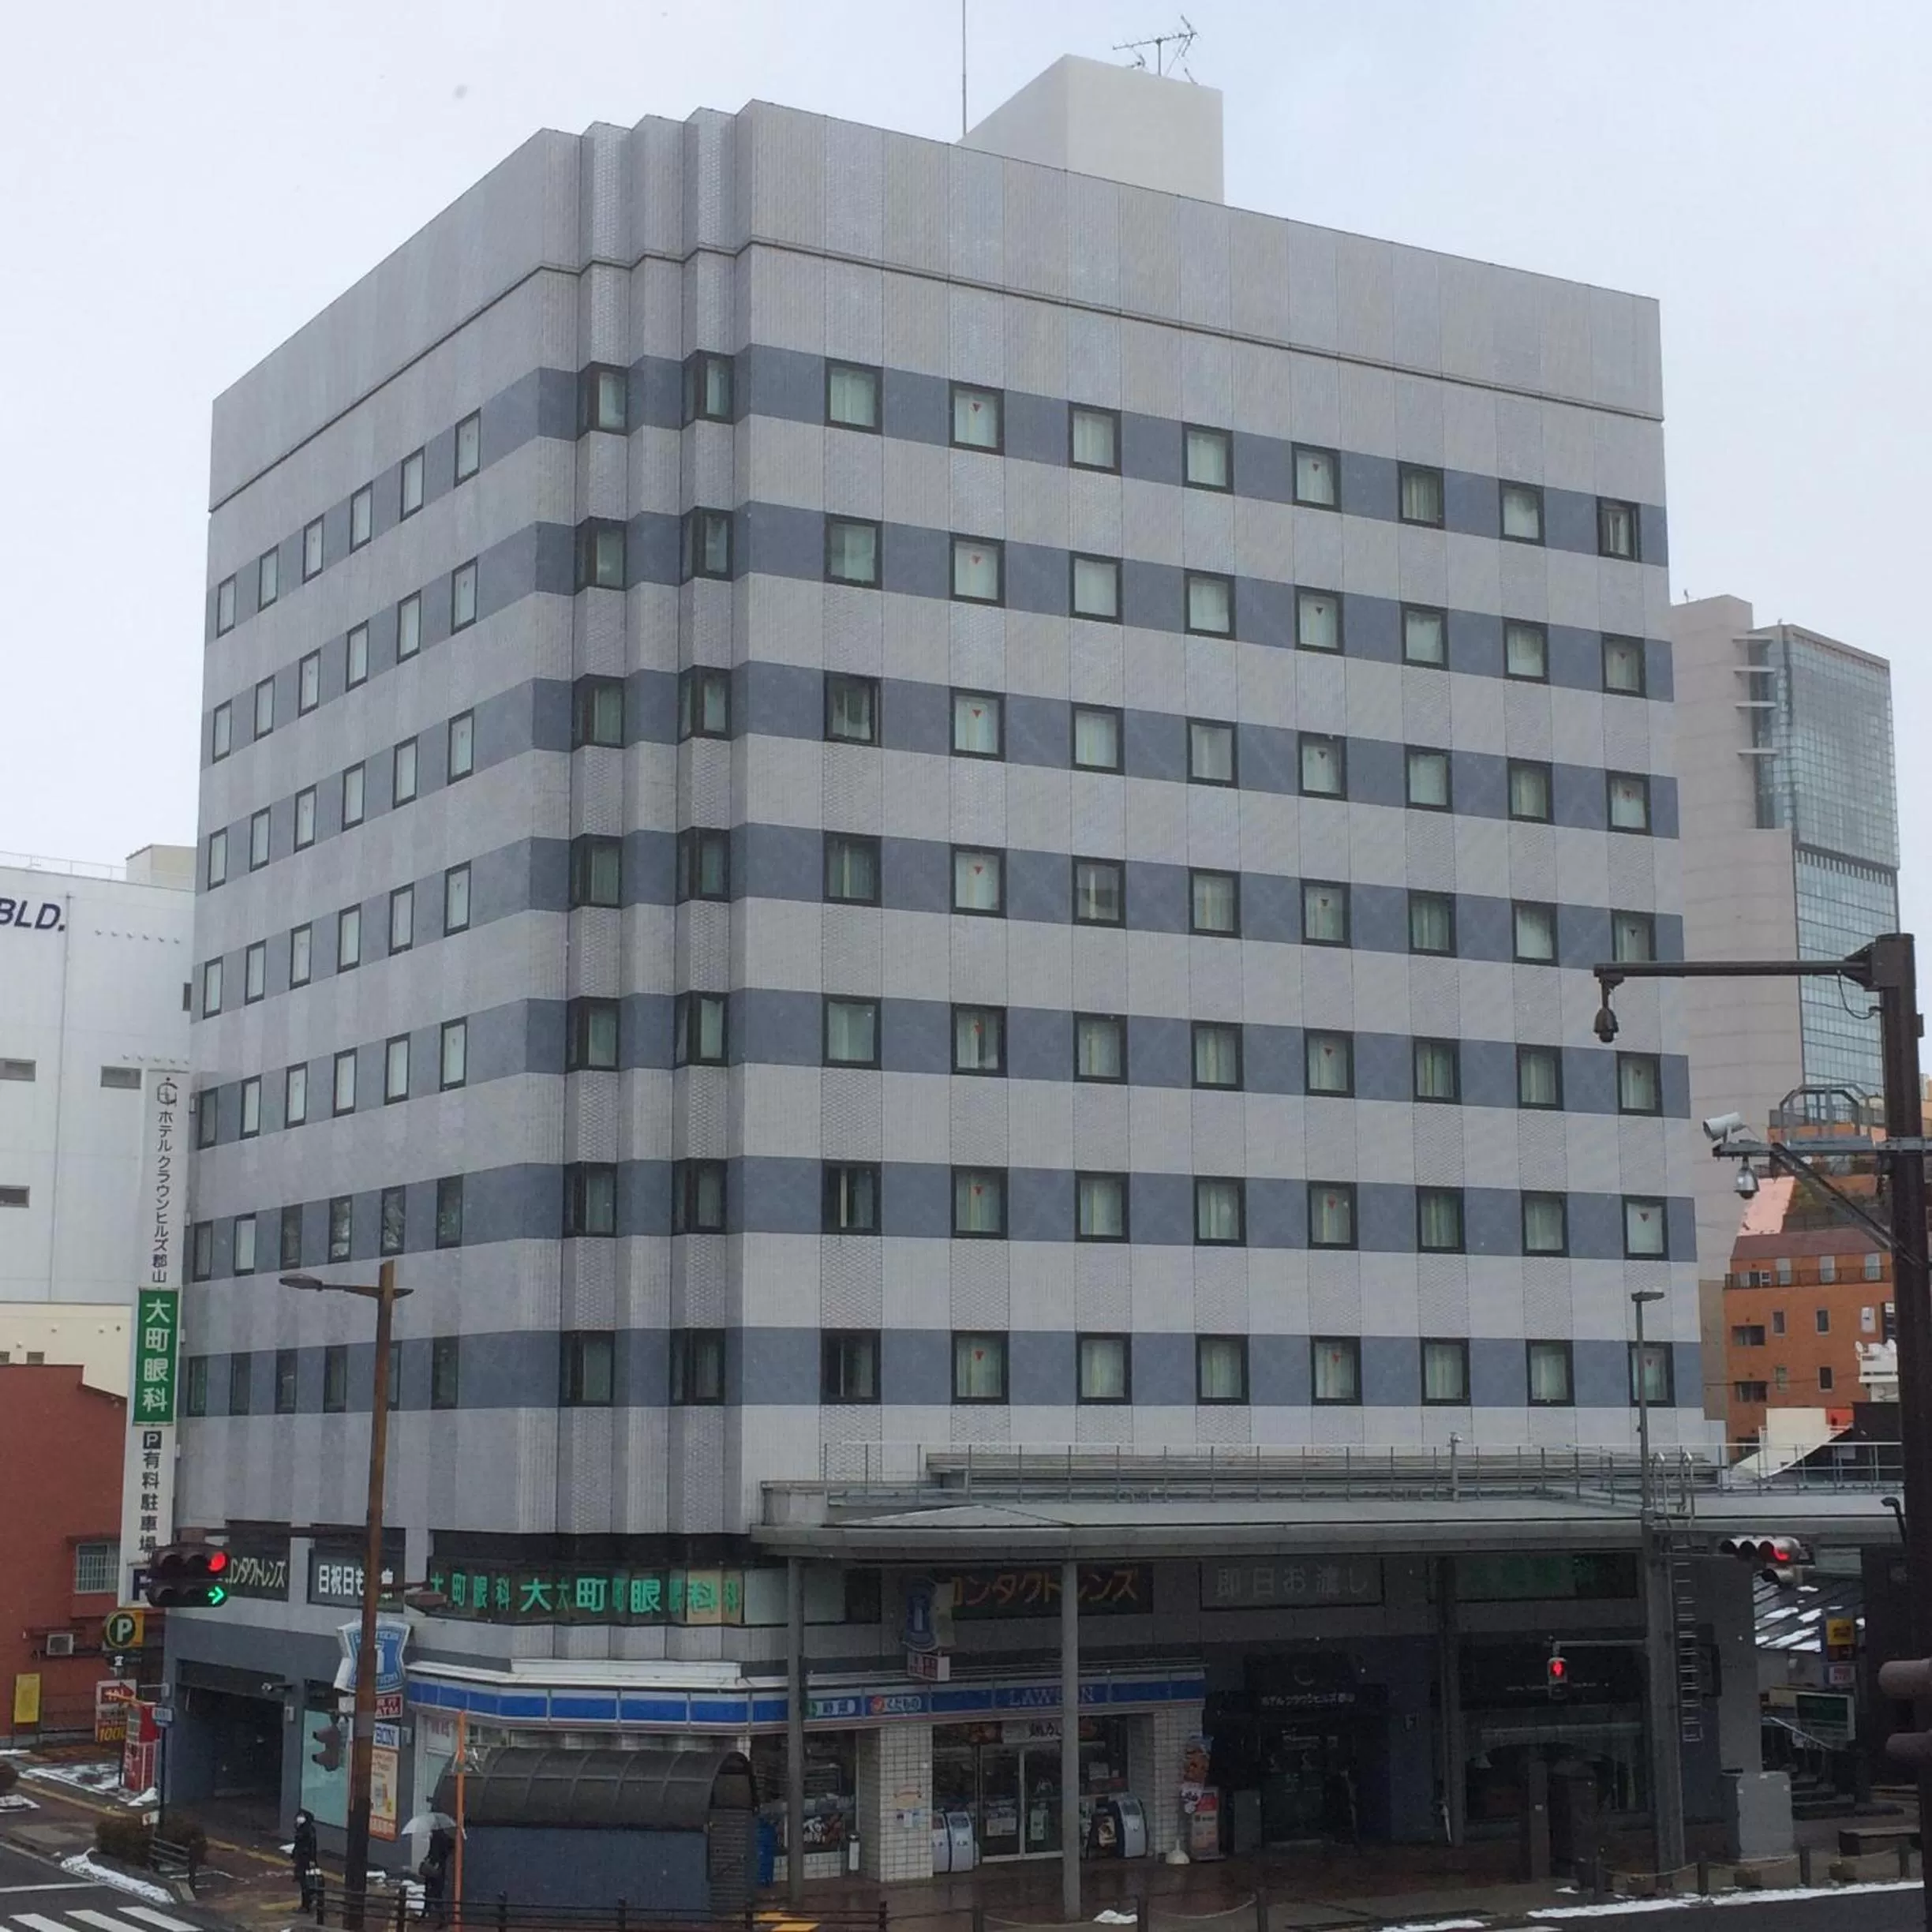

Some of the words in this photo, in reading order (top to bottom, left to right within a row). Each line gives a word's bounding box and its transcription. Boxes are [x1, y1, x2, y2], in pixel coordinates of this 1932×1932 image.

[152, 1110, 174, 1283] ホテルクラウンヒルズ郡山
[142, 1298, 171, 1413] 大町眼科
[139, 1451, 160, 1555] 有料駐車場
[519, 1578, 719, 1613] 大町眼科
[950, 1570, 1139, 1607] コンタクトンズ
[1009, 1685, 1095, 1706] LAWN
